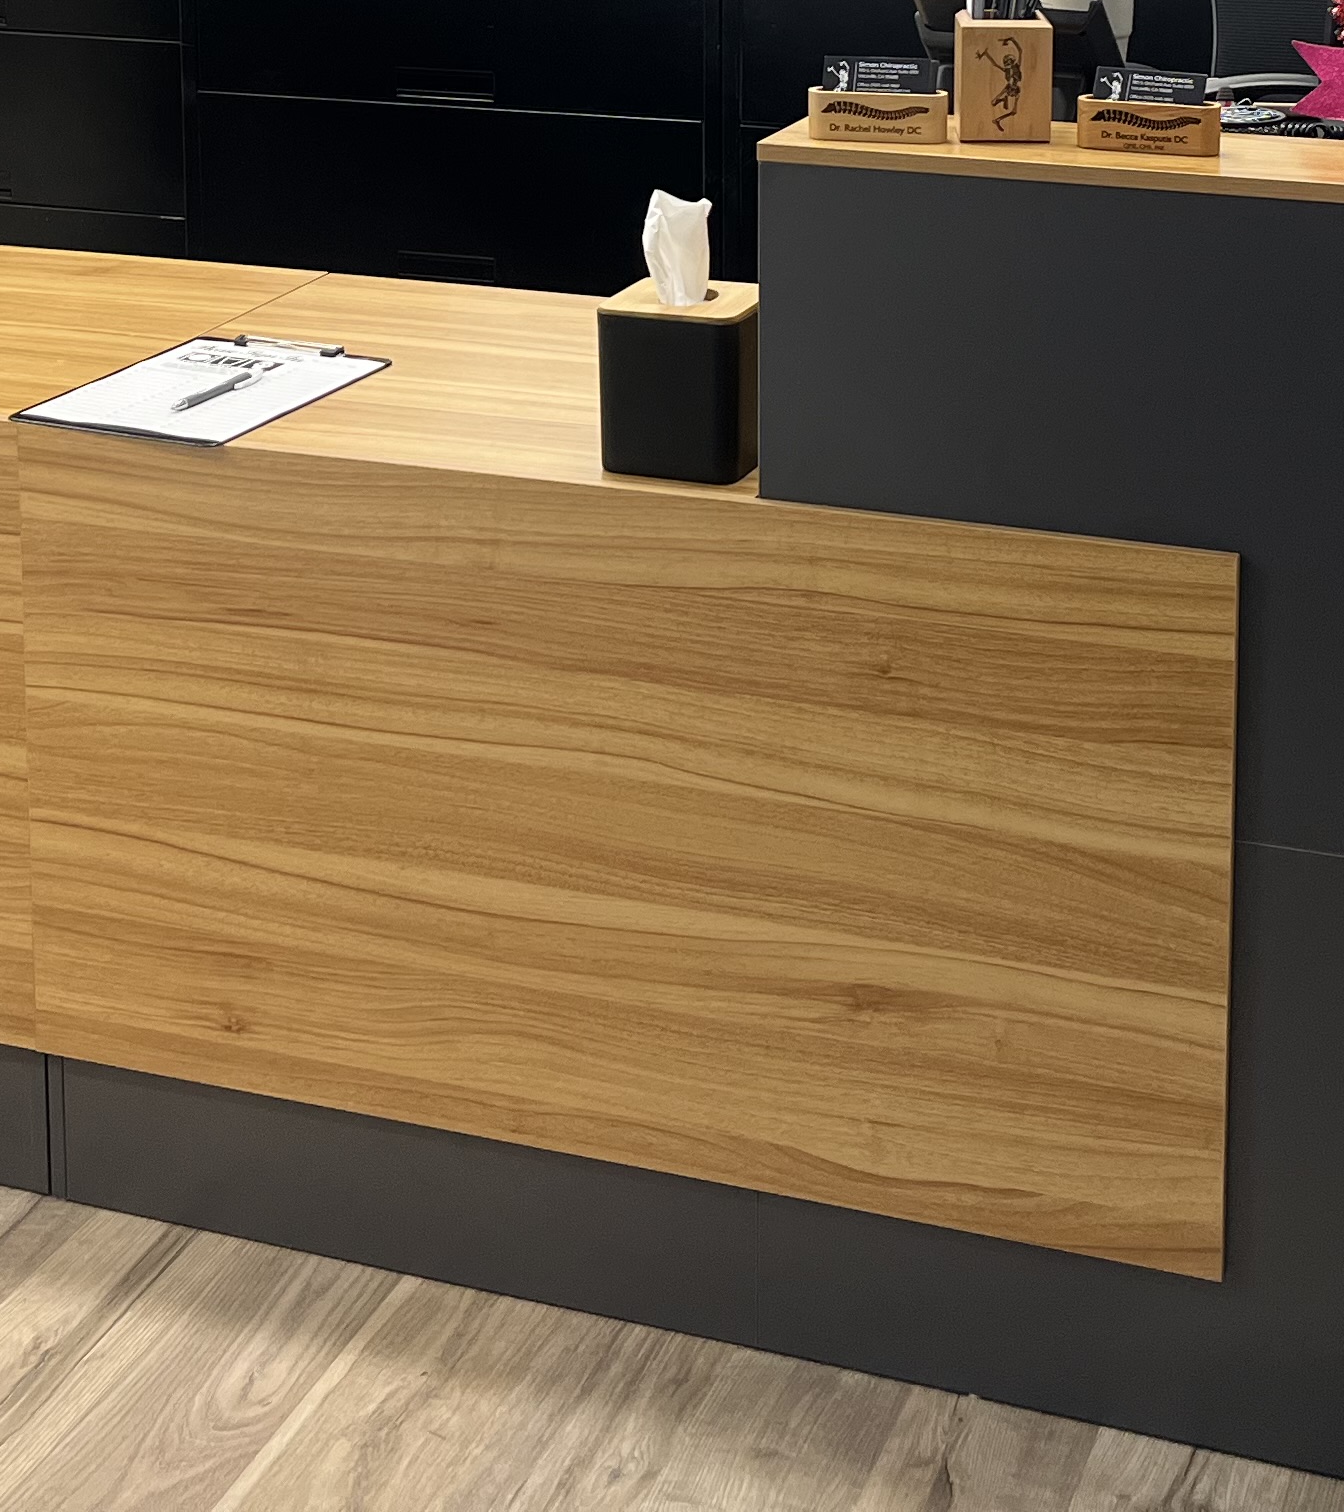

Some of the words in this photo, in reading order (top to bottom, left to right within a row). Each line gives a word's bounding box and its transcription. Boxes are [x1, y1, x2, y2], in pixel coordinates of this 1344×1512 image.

[1154, 75, 1194, 84] Chiropractic
[844, 124, 872, 133] Rachel
[907, 126, 922, 135] DC
[1101, 130, 1113, 139] Dr.
[1116, 131, 1138, 141] Becca
[1174, 135, 1188, 144] DC
